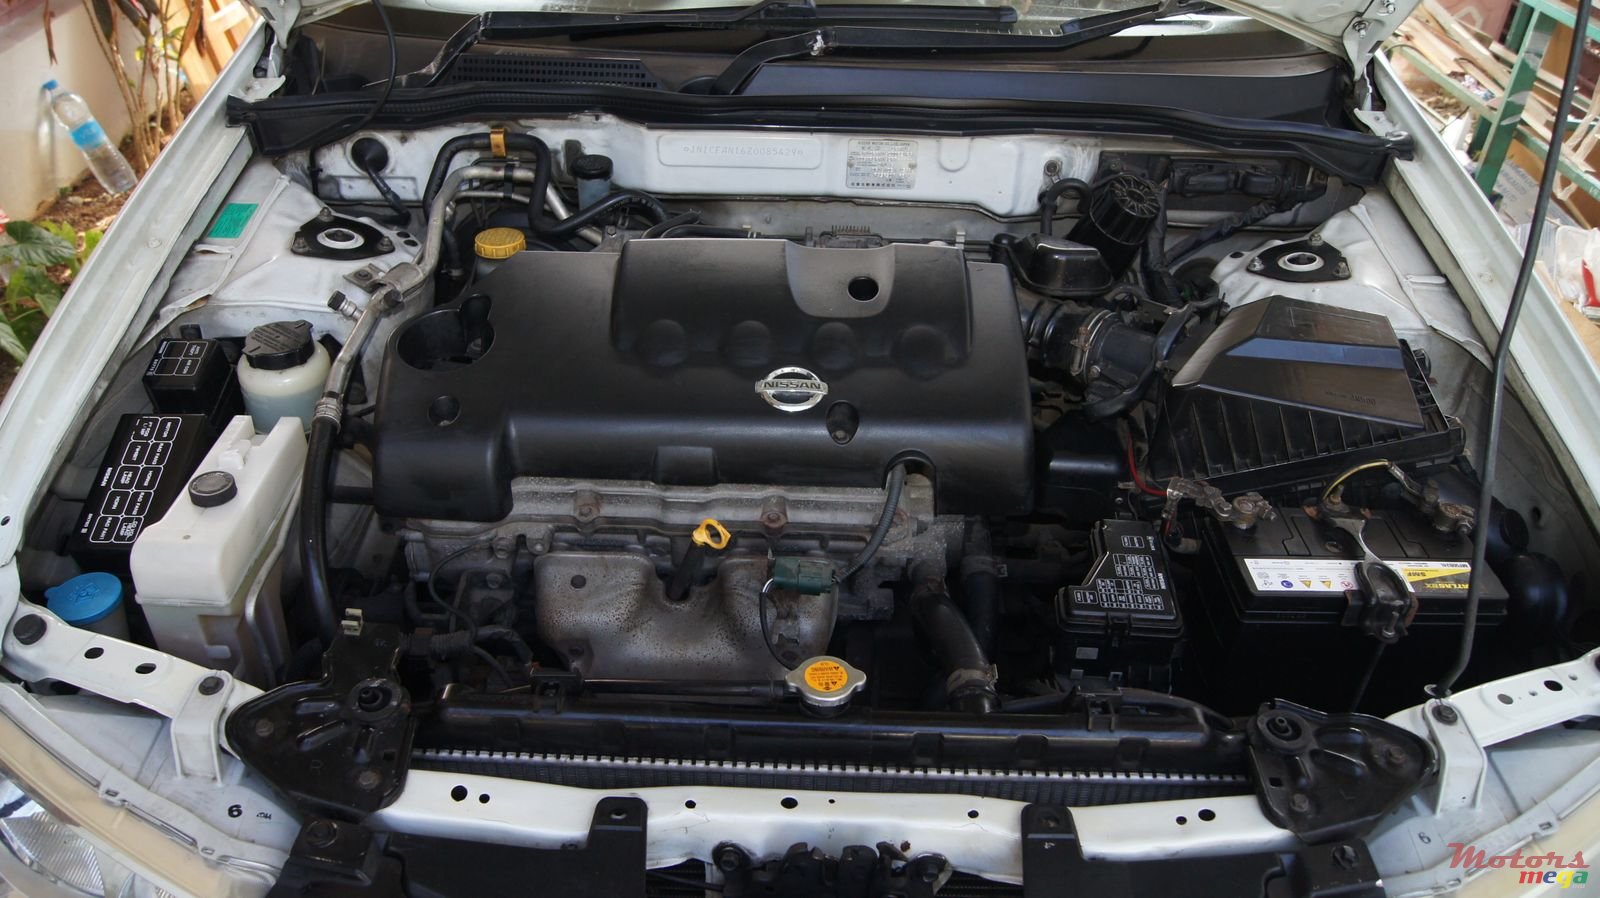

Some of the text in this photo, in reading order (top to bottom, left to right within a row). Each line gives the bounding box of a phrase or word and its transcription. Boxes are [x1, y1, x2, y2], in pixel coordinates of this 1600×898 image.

[764, 381, 821, 390] NISSAN
[162, 421, 172, 438] MOTOR
[100, 467, 113, 487] NISSAN
[228, 804, 243, 818] 6
[1418, 831, 1432, 845] 6
